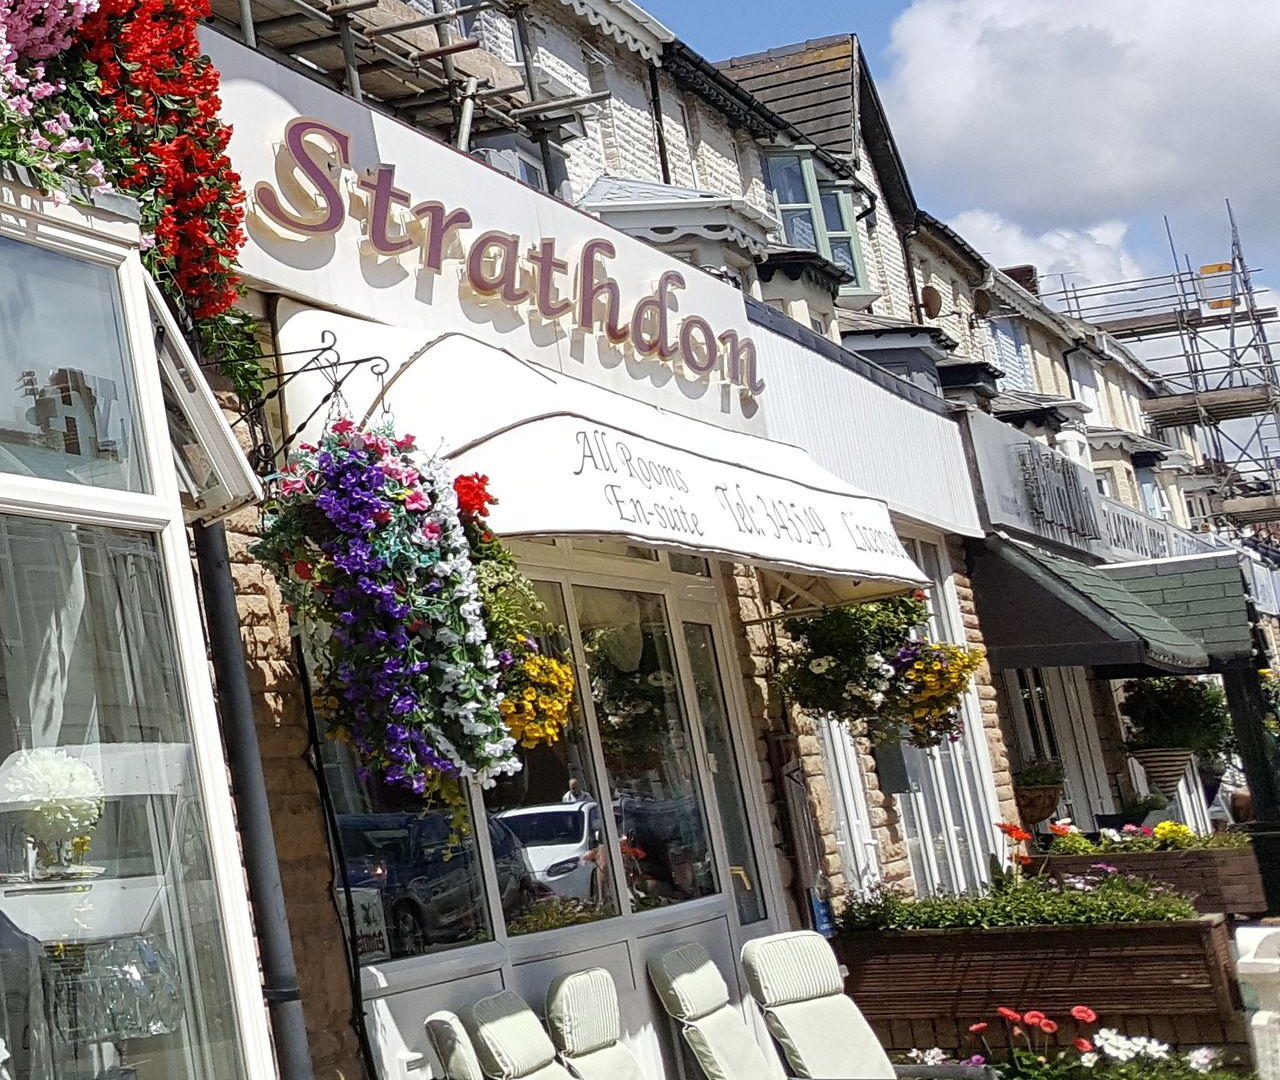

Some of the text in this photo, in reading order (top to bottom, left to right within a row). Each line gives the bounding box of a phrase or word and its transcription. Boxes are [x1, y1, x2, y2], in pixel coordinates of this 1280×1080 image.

[254, 117, 765, 396] Strathdon
[573, 430, 689, 493] All Rooms
[604, 484, 704, 536] En-suite
[715, 483, 766, 537] Tel:
